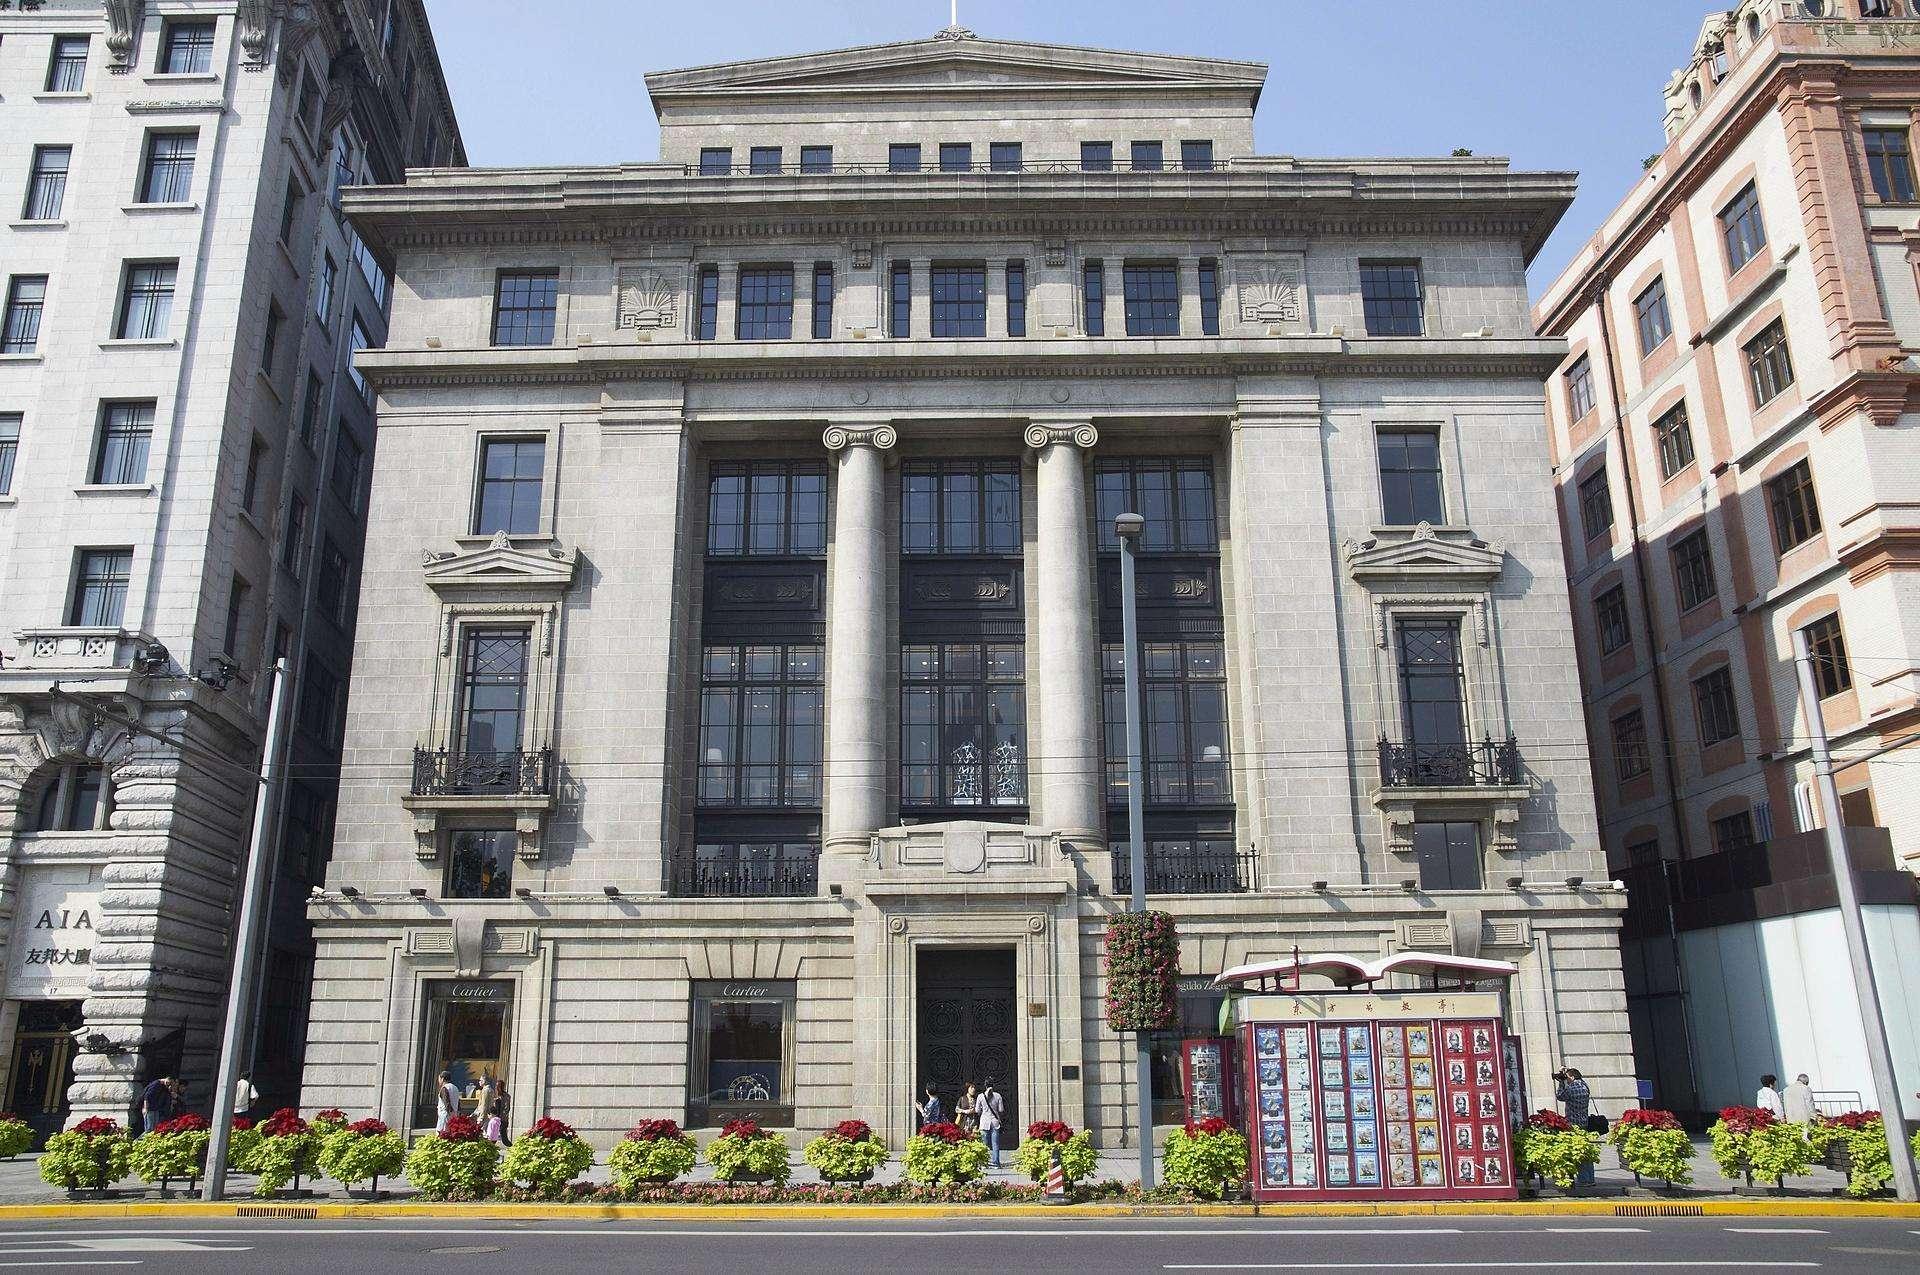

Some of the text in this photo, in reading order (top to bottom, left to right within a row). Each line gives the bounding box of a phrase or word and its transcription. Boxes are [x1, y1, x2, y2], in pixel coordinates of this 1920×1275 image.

[34, 909, 93, 929] AIA
[452, 984, 497, 997] Cartier
[723, 984, 768, 996] Cartier
